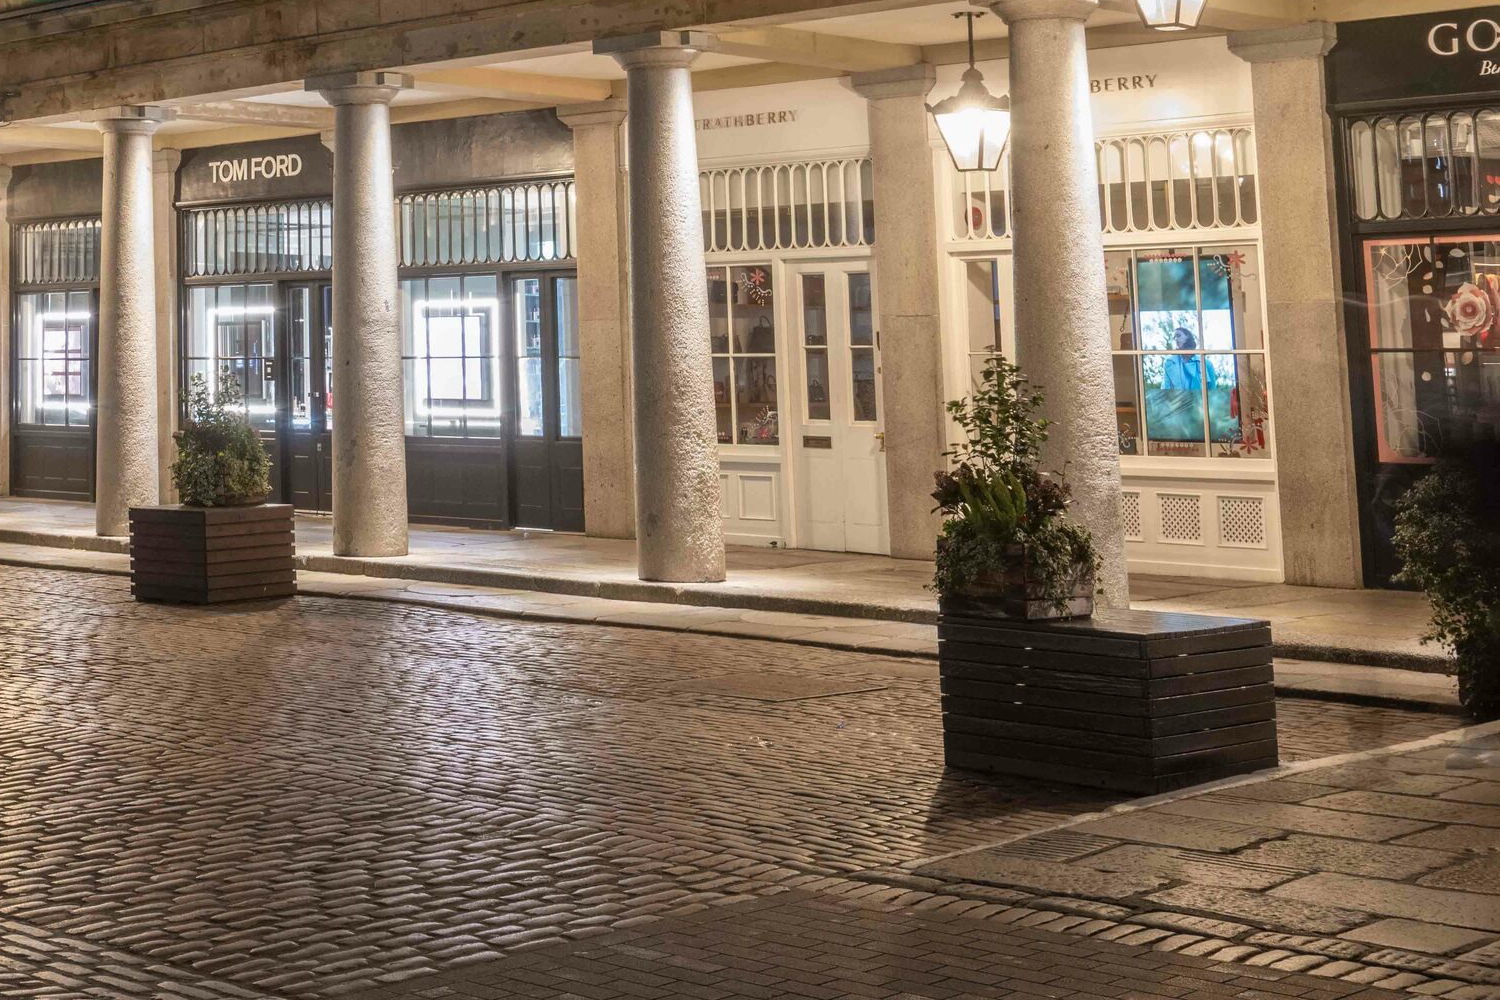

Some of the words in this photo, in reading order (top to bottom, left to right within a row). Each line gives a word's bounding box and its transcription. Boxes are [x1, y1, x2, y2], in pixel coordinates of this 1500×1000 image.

[1427, 18, 1500, 56] GO
[1479, 60, 1500, 76] Be
[208, 158, 248, 183] TOM
[250, 153, 303, 179] FORD
